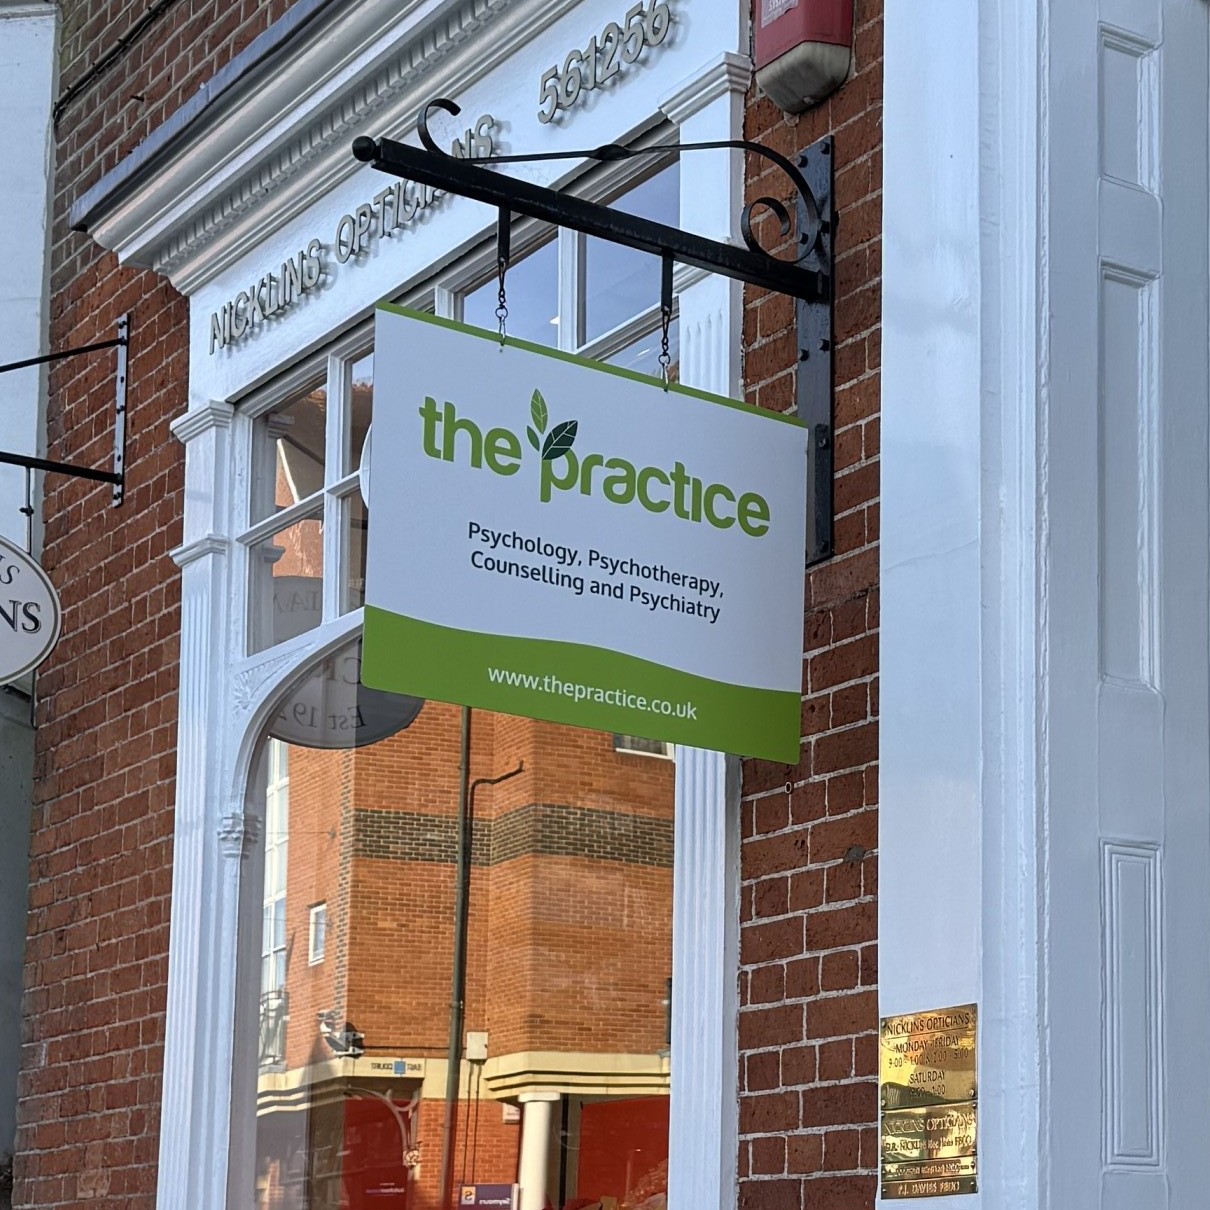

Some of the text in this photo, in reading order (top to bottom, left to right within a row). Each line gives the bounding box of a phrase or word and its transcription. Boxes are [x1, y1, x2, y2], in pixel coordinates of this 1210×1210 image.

[209, 238, 321, 355] NICKLINS
[537, 0, 671, 124] 561256
[418, 396, 771, 538] the practice
[468, 521, 724, 599] Psychology, Psychotherapy,
[470, 550, 721, 624] Counselling and Psychiatry
[487, 667, 698, 720] www.thepractice.co.uk
[886, 1012, 970, 1036] NICKLINS OPTICIANS
[895, 1040, 928, 1053] MONDAY
[909, 1069, 946, 1085] SATURDAY
